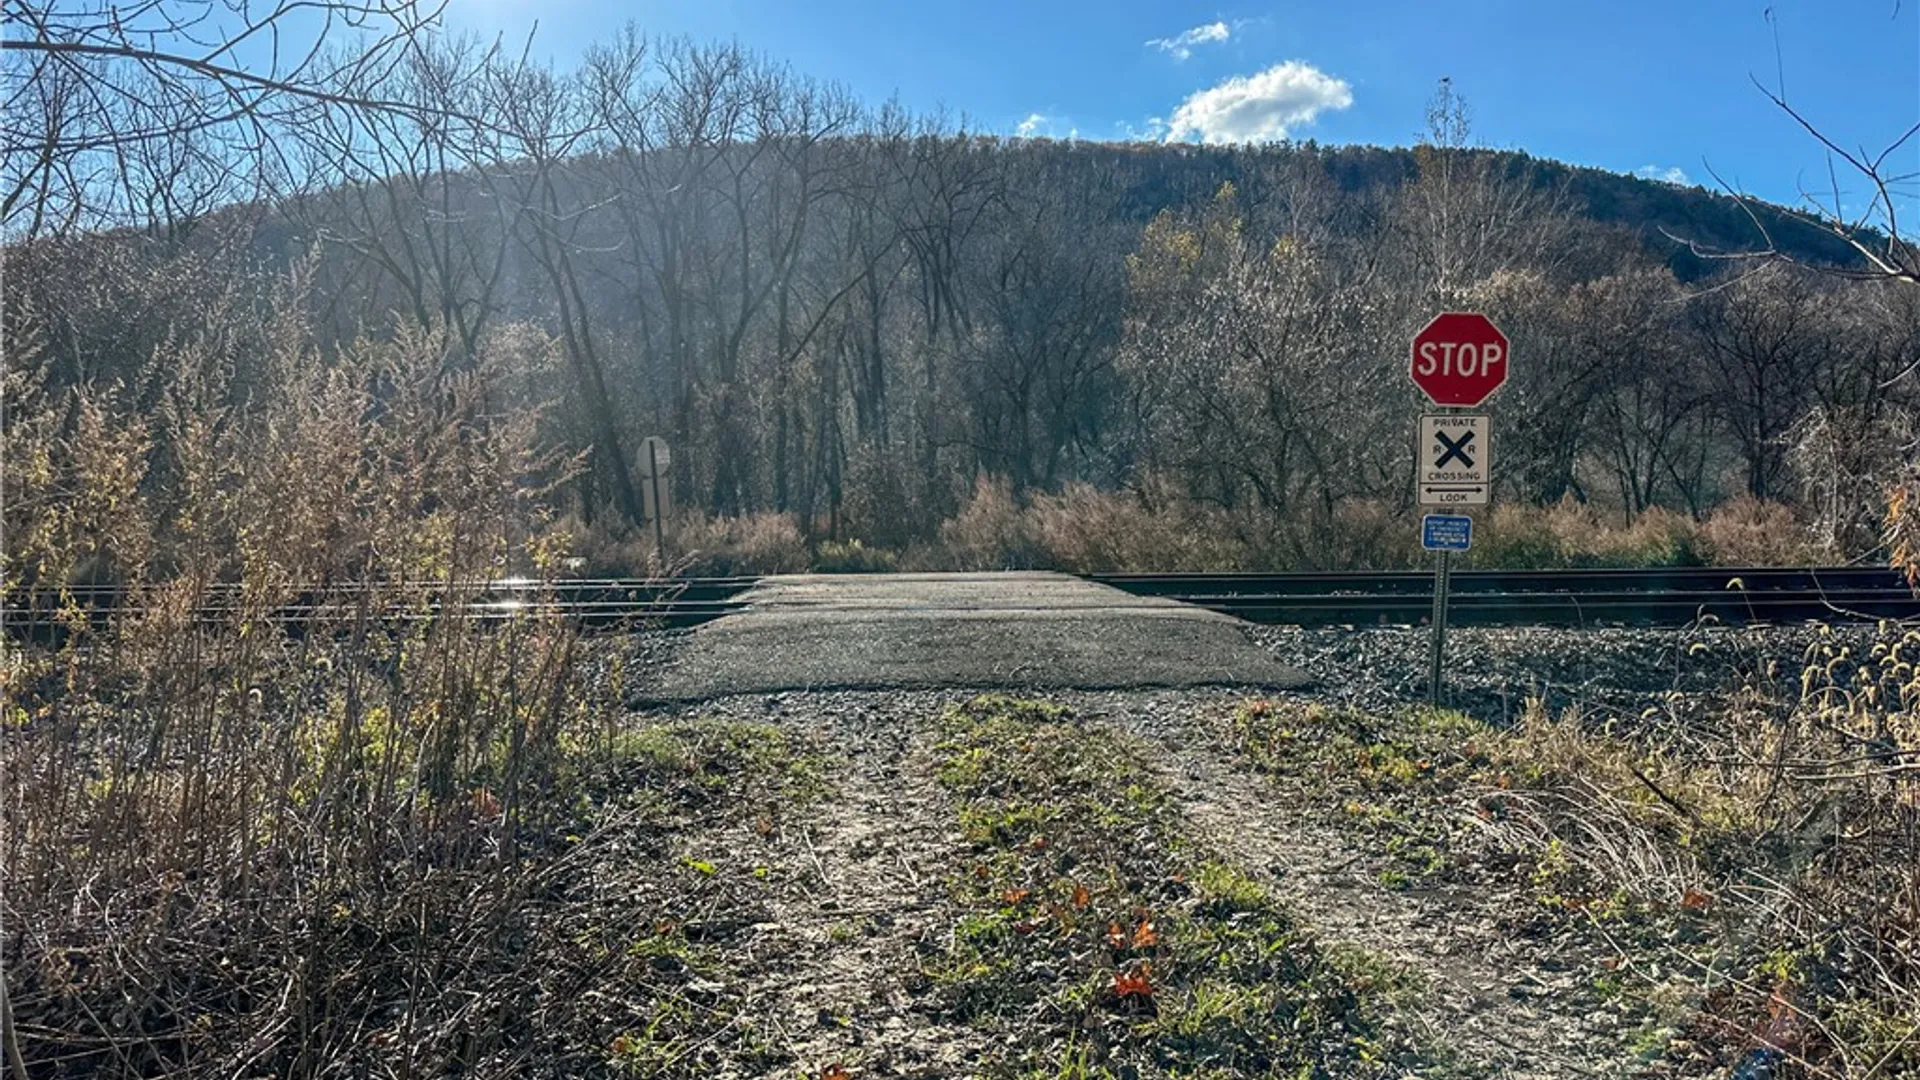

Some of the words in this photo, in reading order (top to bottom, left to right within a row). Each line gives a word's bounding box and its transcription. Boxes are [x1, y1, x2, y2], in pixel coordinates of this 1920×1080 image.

[1418, 342, 1502, 377] STOP
[1433, 418, 1477, 427] PRIVATE
[1433, 444, 1441, 454] R
[1468, 444, 1476, 454] R
[1428, 472, 1480, 481] CROSSING
[1440, 494, 1467, 502] LOOK
